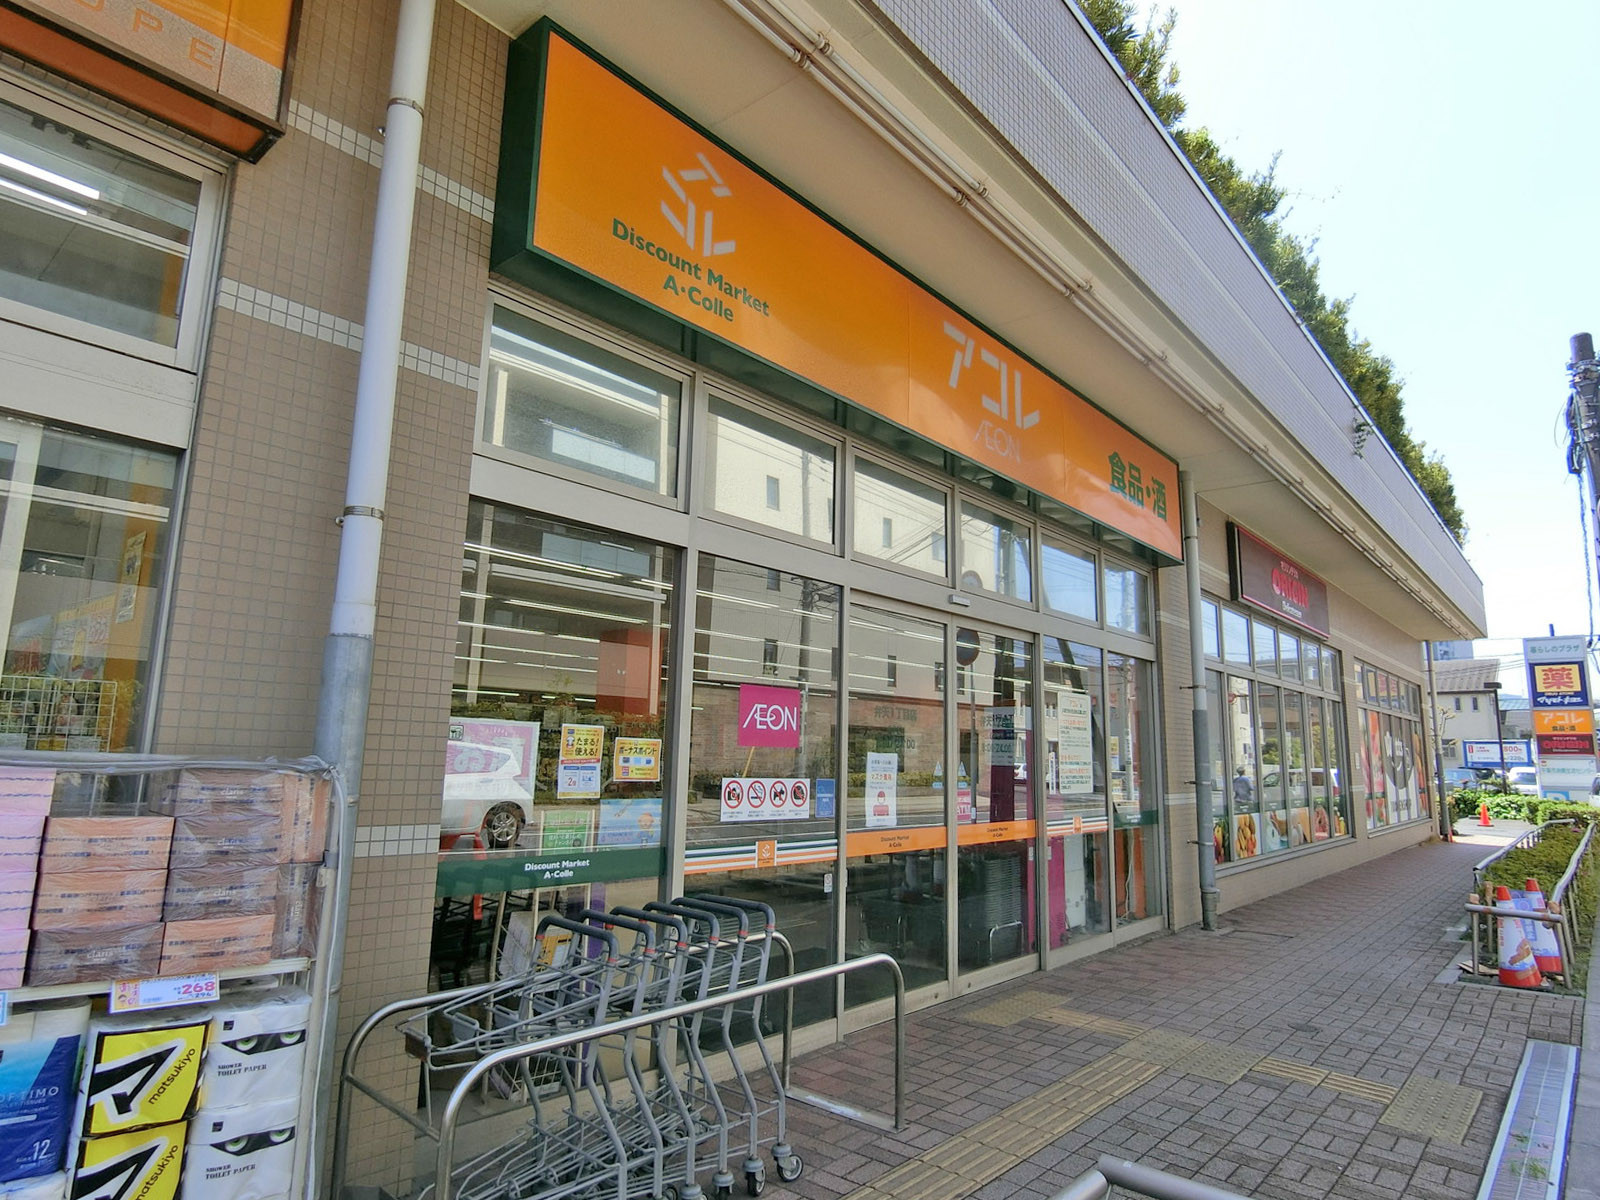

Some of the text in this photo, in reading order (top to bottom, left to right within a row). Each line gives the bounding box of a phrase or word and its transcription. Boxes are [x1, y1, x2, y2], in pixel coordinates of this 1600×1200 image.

[612, 218, 770, 317] Discount Market
[943, 320, 1040, 430] アコレ
[1541, 667, 1574, 689] 薬
[1541, 712, 1584, 725] アコレ
[524, 859, 591, 872] Discount Market
[182, 981, 216, 995] 268
[217, 1062, 243, 1070] SHOWER
[217, 1064, 267, 1077] TOILET PAPER
[148, 1048, 196, 1105] matsukiyo
[33, 1138, 51, 1161] 12
[205, 1164, 256, 1180] TOILET PAPER
[206, 1164, 231, 1172] SHOWER
